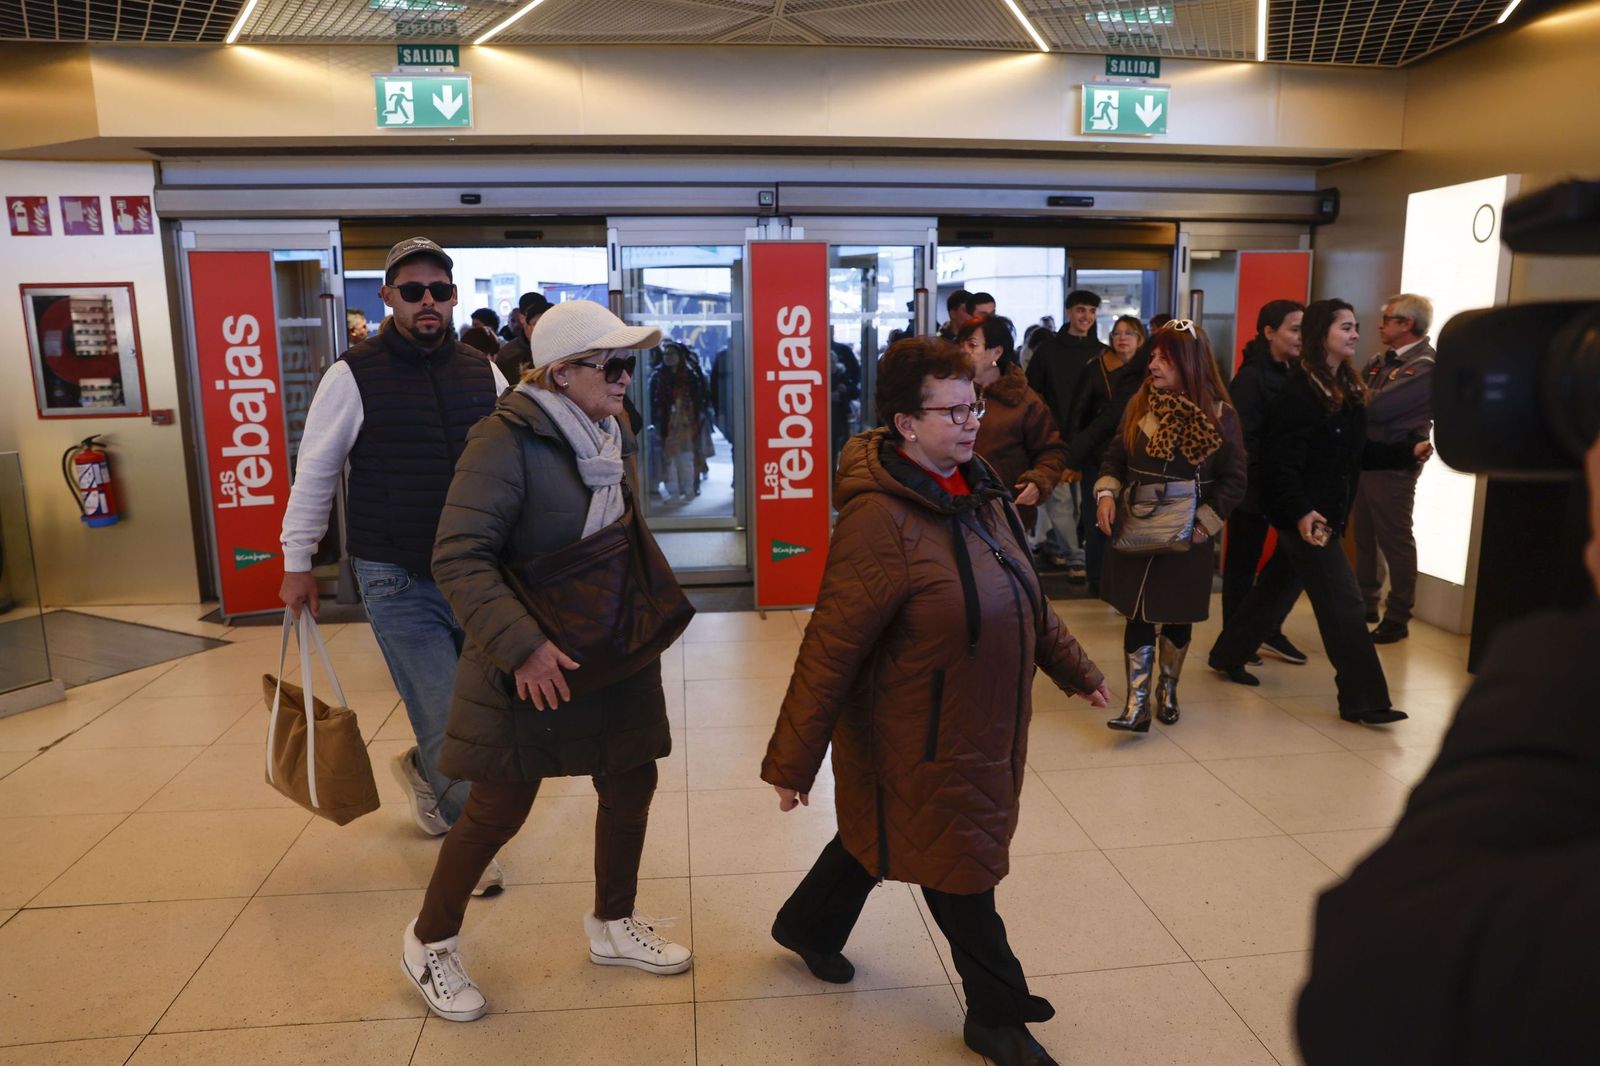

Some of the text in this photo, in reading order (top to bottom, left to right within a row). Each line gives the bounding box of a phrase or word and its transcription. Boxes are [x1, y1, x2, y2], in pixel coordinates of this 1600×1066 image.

[403, 49, 454, 63] SALIDA
[1110, 60, 1156, 75] SALIDA
[215, 314, 276, 507] rebajas
[766, 305, 822, 499] rebajas
[217, 470, 238, 509] Las
[760, 461, 779, 500] Las
